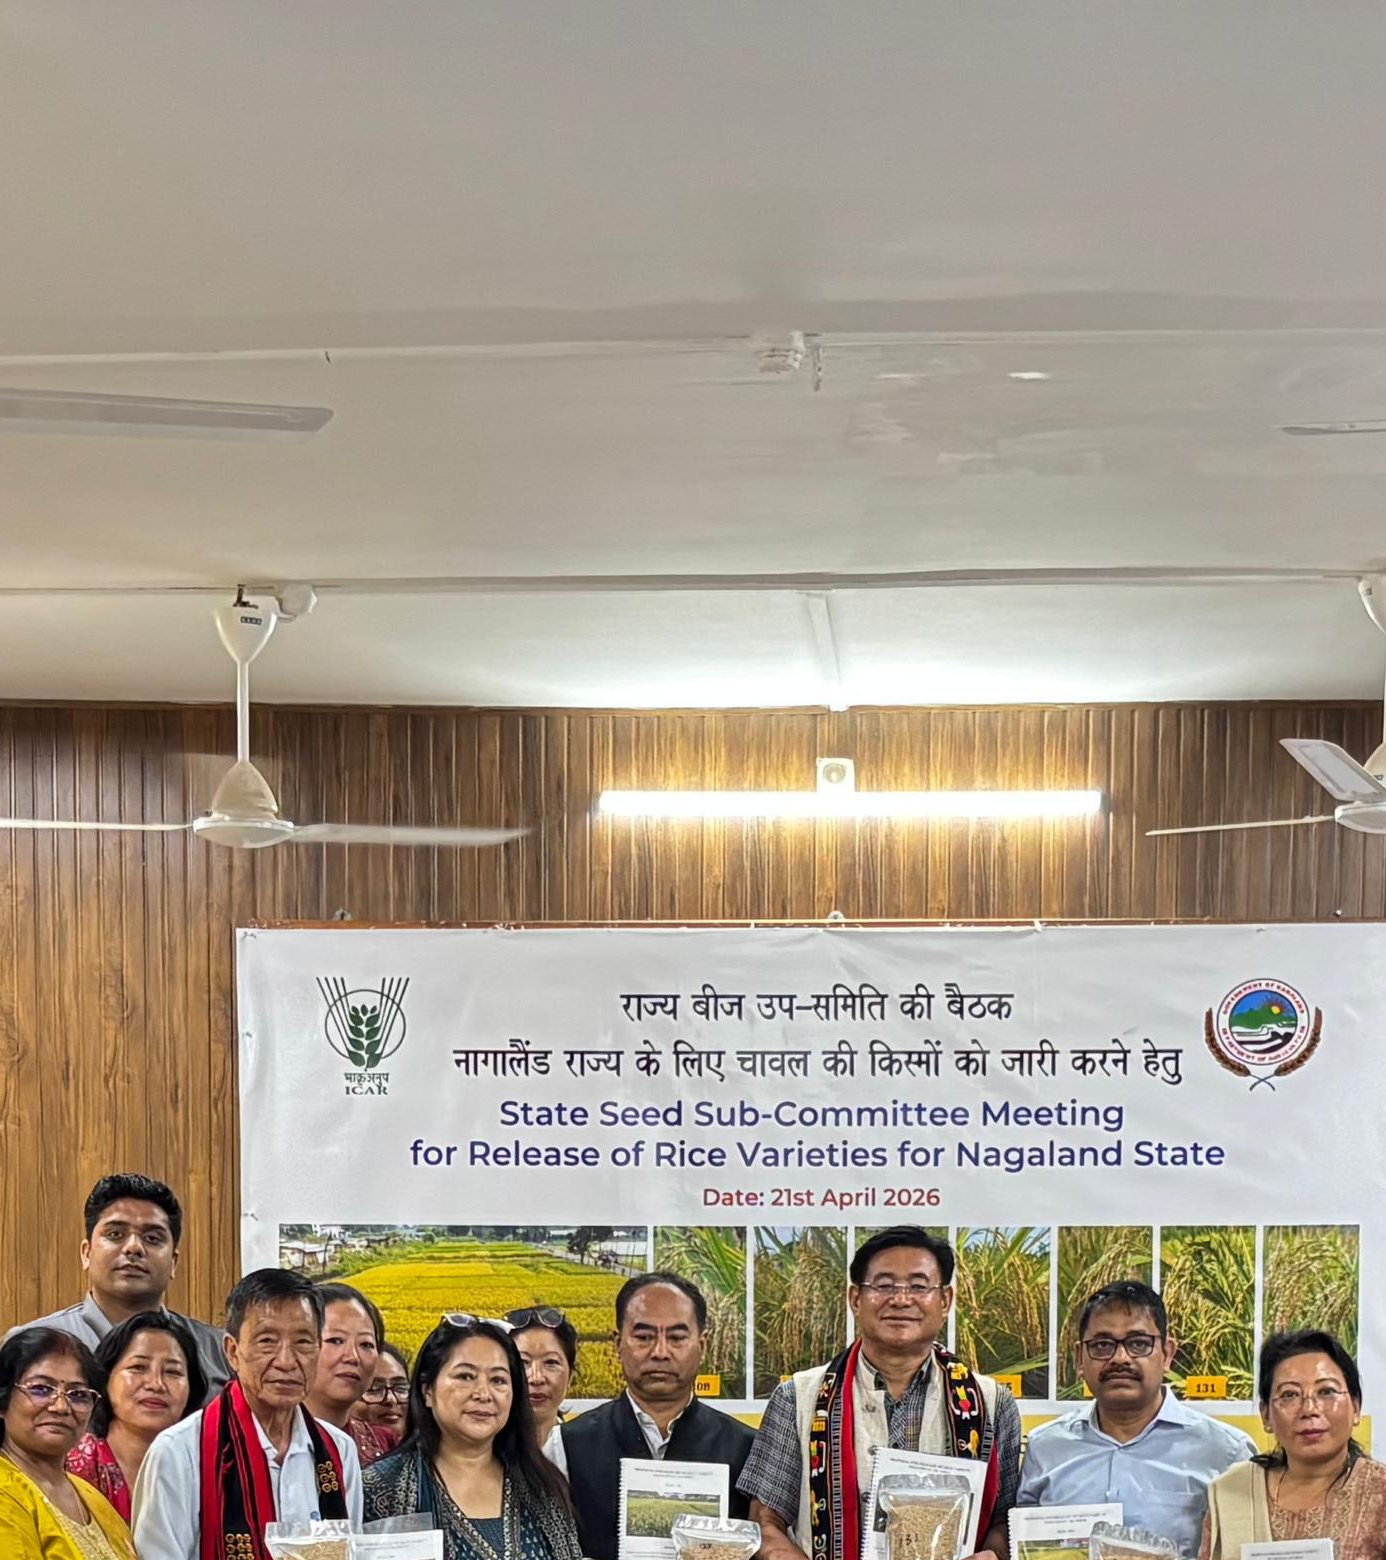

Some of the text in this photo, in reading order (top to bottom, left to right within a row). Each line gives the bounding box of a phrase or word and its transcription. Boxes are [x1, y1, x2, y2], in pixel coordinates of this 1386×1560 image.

[619, 994, 681, 1021] राज्य
[691, 984, 746, 1021] बीज
[899, 983, 935, 1021] की
[944, 983, 1014, 1021] बैठक
[453, 1039, 553, 1077] नागालैंड
[563, 1050, 624, 1077] राज्य
[634, 1039, 662, 1077] के
[672, 1040, 726, 1082] लिए
[736, 1050, 811, 1077] चावल
[822, 1040, 858, 1077] की
[868, 1039, 943, 1077] किस्मों
[954, 1039, 990, 1077] को
[1001, 1039, 1060, 1077] जारी
[1070, 1038, 1131, 1077] करने
[1142, 1038, 1184, 1085] हेतु
[345, 1086, 389, 1095] ICAR
[500, 1098, 1124, 1133] State Seed Sub-Committee Meeting
[410, 1139, 1226, 1174] for Release of Rice Varieties for Nagaland State
[703, 1187, 941, 1211] Date: 21st April 2026
